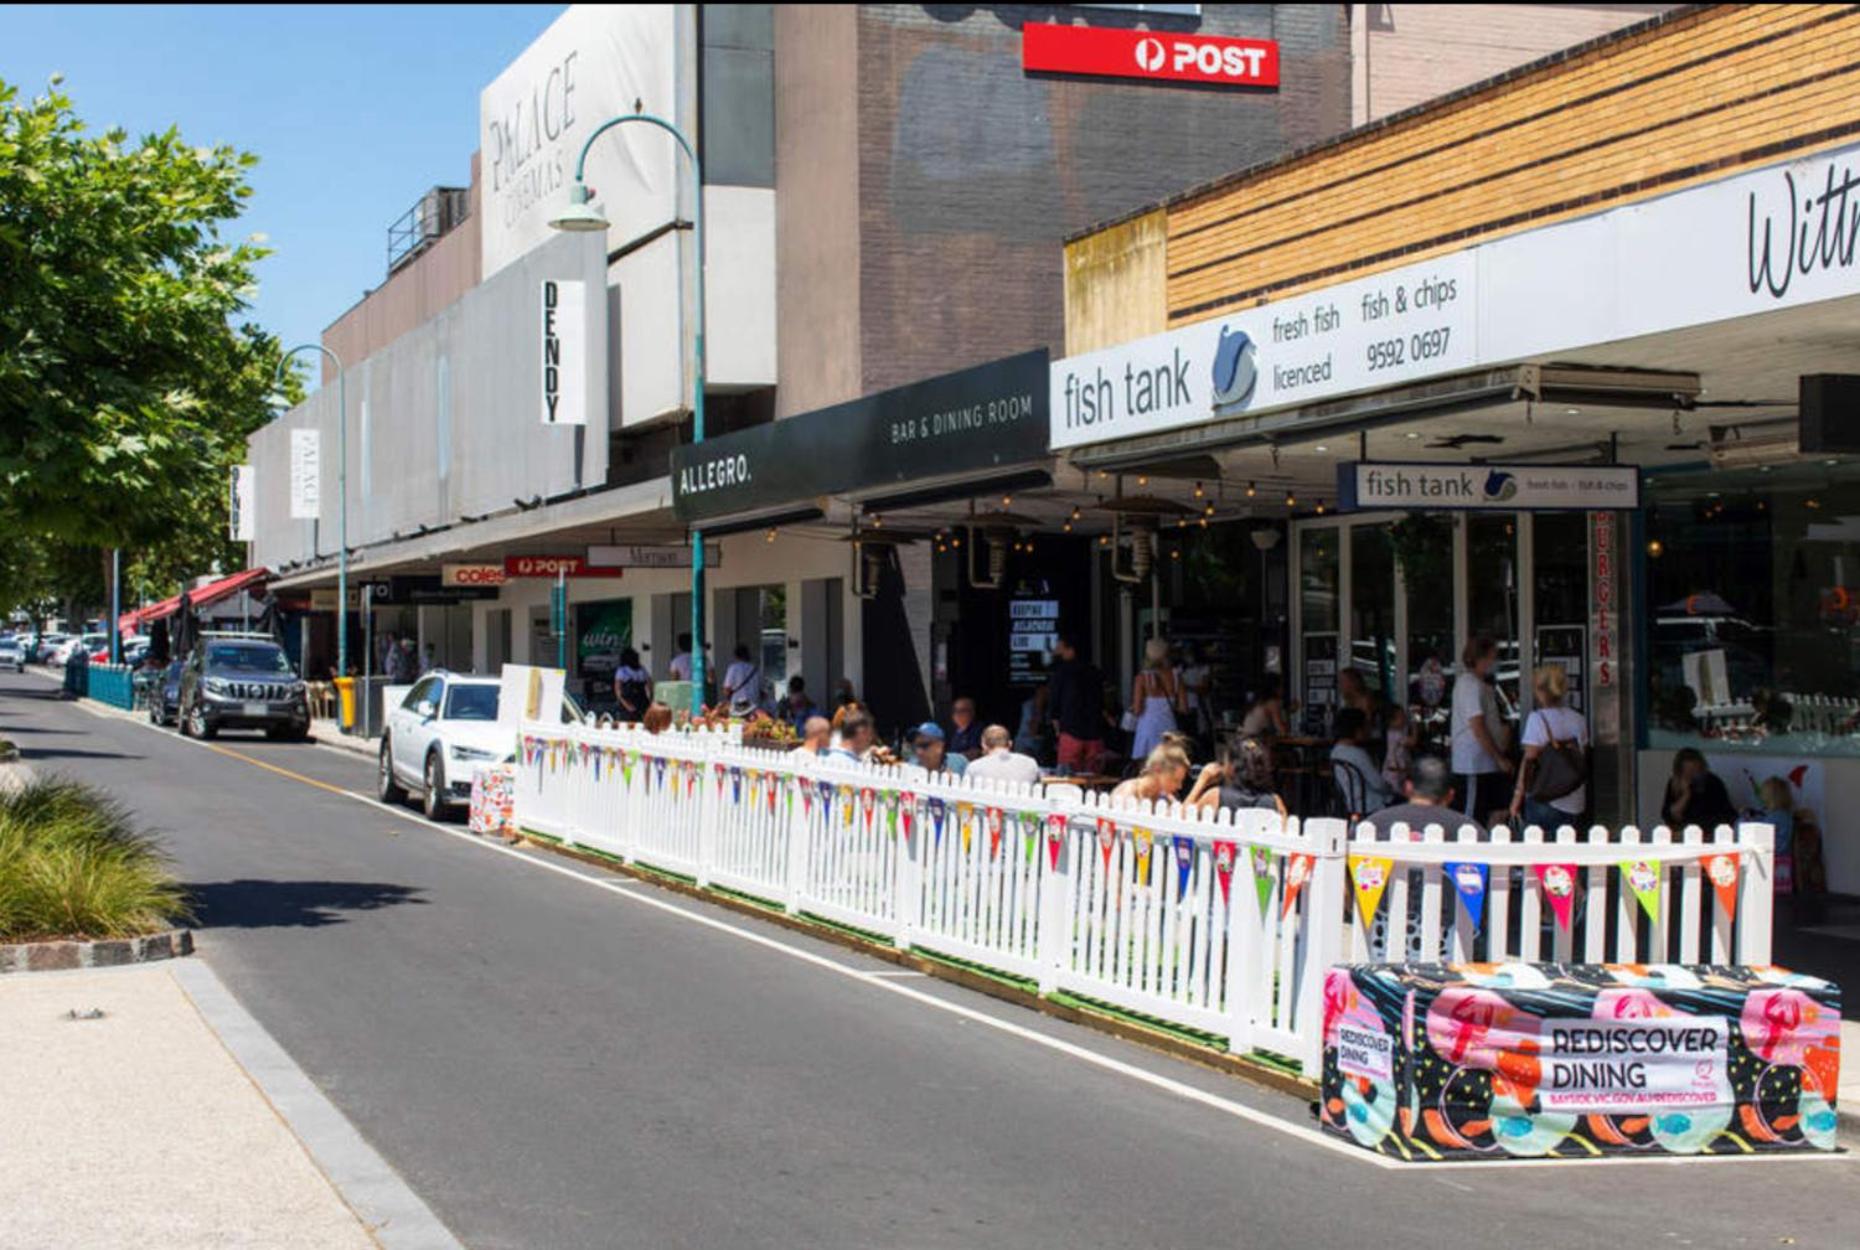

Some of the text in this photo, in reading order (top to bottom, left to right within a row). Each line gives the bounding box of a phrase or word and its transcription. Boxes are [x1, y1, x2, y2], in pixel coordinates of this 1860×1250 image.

[1173, 42, 1267, 77] POST
[490, 50, 578, 192] PALACE
[1361, 275, 1457, 323] fish & chips
[1273, 303, 1341, 343] fresh fish
[545, 281, 560, 422] DENDY
[1367, 326, 1450, 372] 9592 0697
[1065, 346, 1191, 429] fish tank
[1273, 352, 1332, 392] licenced
[892, 419, 916, 444] BAR
[933, 404, 982, 435] DINING
[988, 395, 1033, 423] ROOM
[680, 453, 753, 495] ALLEGRO.
[1367, 471, 1473, 496] fish tank
[456, 567, 506, 584] coles
[1553, 1028, 1718, 1053] REDISCOVER
[1553, 1062, 1647, 1088] DINING
